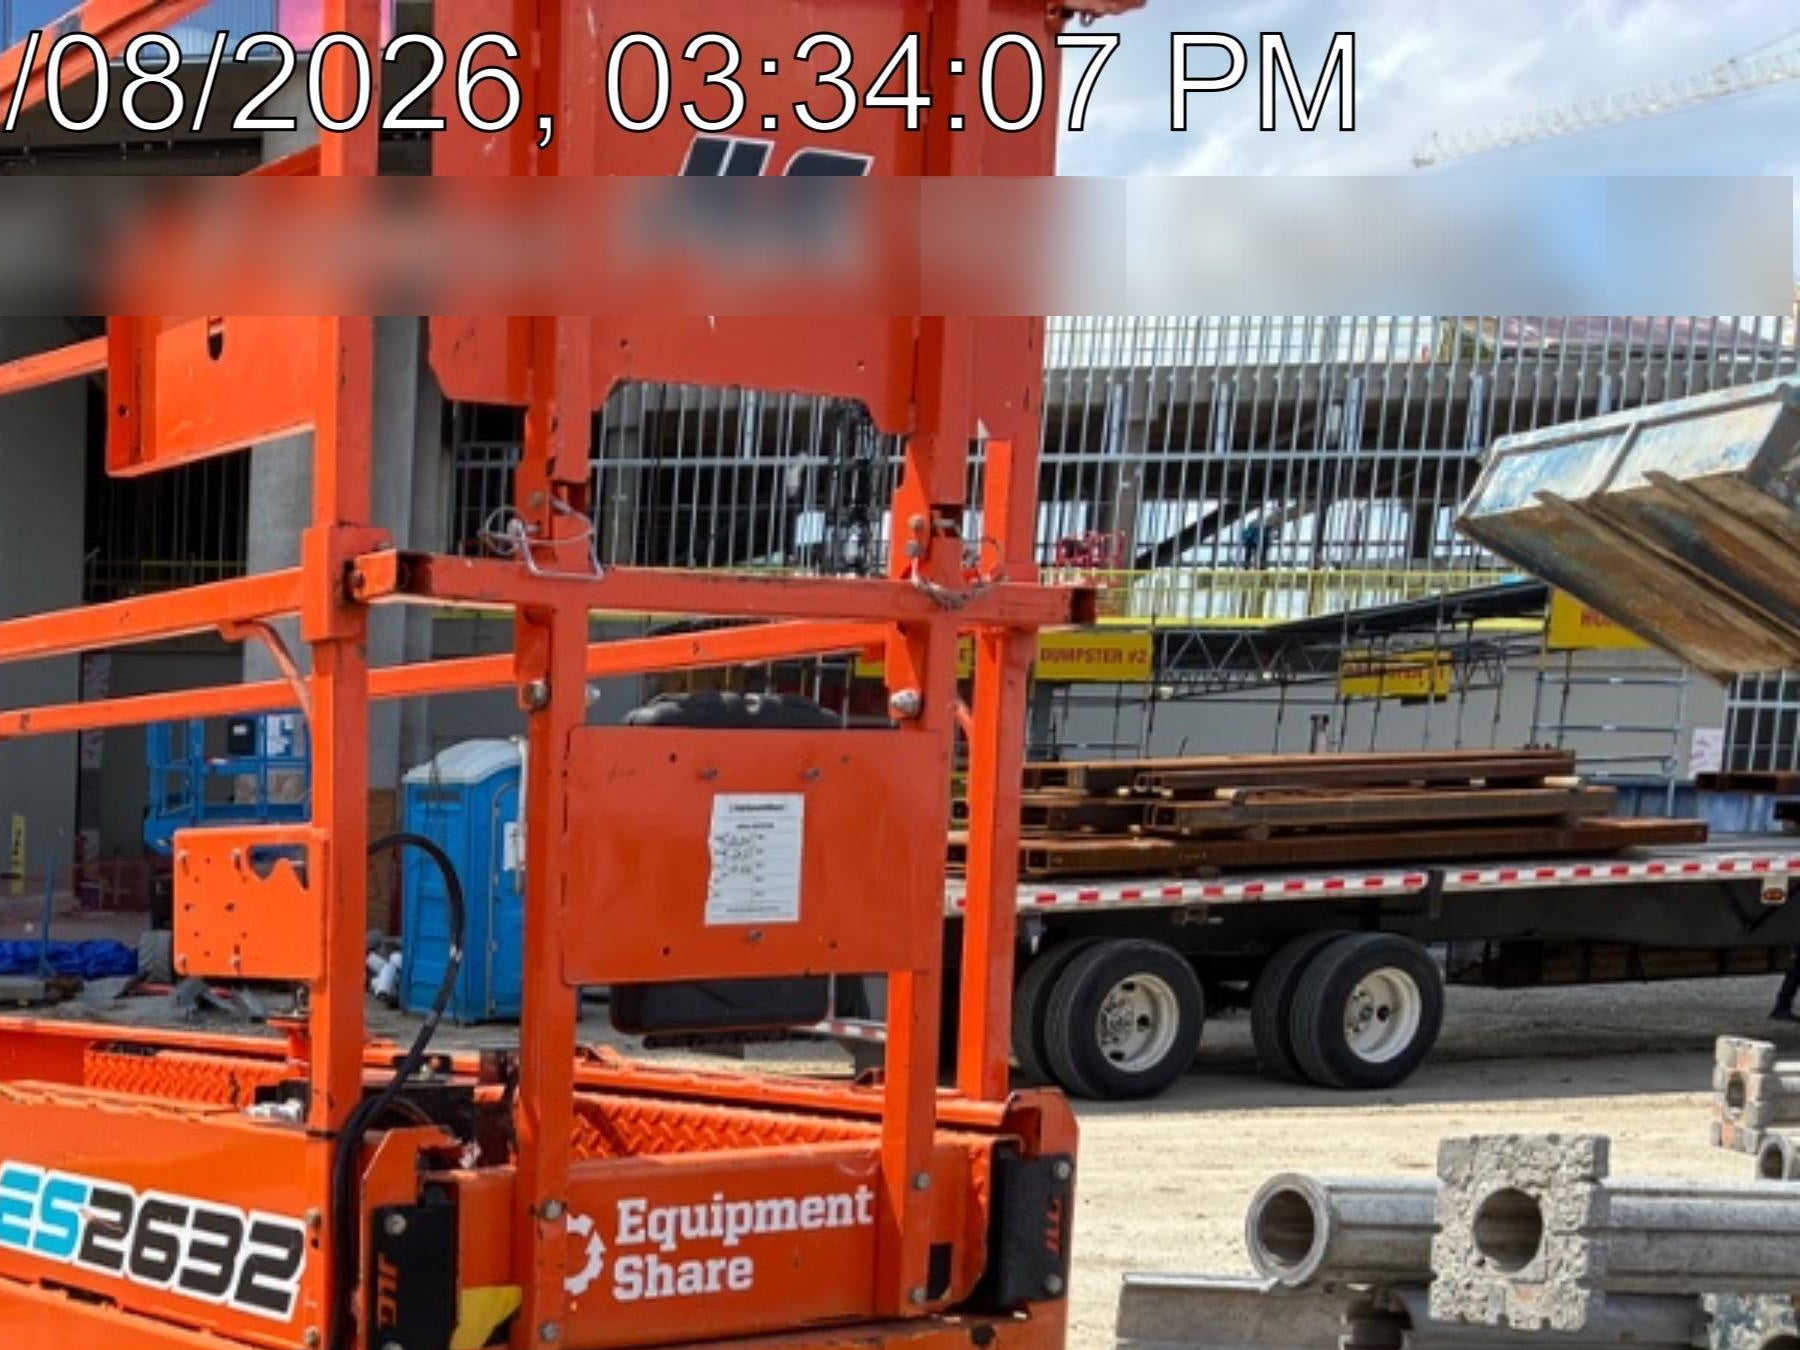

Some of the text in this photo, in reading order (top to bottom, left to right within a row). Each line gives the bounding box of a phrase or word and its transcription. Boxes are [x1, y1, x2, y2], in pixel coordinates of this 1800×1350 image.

[1041, 647, 1122, 664] DUMPSTER
[616, 1186, 875, 1247] Equipment
[378, 1253, 398, 1329] JLG
[612, 1254, 754, 1302] Share
